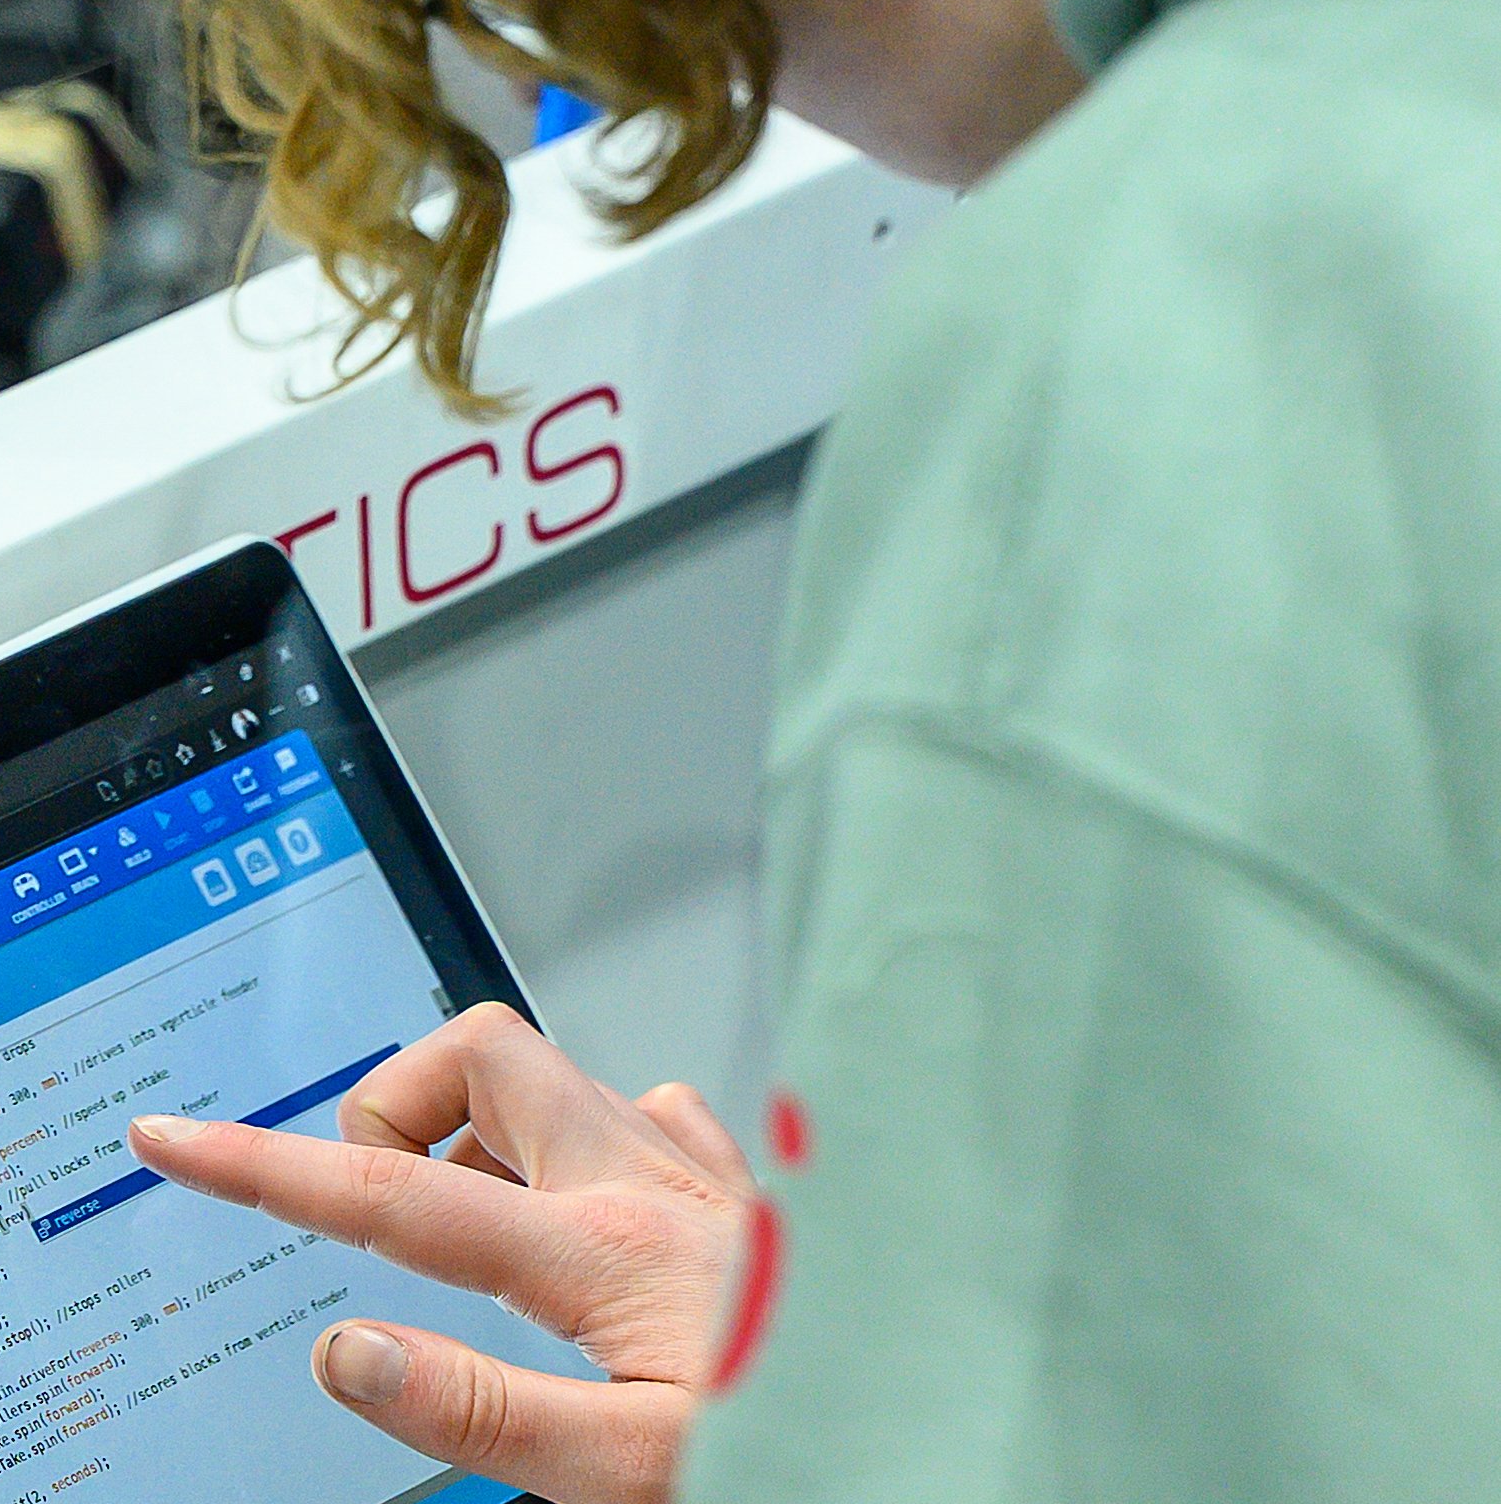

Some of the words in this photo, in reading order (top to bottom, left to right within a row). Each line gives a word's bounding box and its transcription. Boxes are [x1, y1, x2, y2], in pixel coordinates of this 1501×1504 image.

[2, 1039, 35, 1061] drops
[8, 1086, 37, 1105] 300,
[40, 1070, 68, 1089] mm);
[73, 1043, 124, 1076] //drives
[129, 1028, 156, 1047] into
[63, 1095, 108, 1128] //speed
[109, 1086, 129, 1106] up
[131, 1069, 170, 1093] intake
[8, 1173, 47, 1204] //pull
[48, 1155, 90, 1180] blocks
[93, 1139, 123, 1158] from
[53, 1198, 101, 1227] reverse
[56, 1293, 101, 1323] //stops
[106, 1267, 151, 1296] rollers
[130, 1312, 159, 1332] 300,
[195, 1268, 246, 1301] //drives
[248, 1251, 278, 1272] back
[279, 1243, 296, 1256] to
[298, 1226, 327, 1247] lon
[126, 1374, 177, 1409] //scores
[179, 1352, 221, 1379] blocks
[224, 1336, 252, 1356] from
[255, 1309, 307, 1340] verticle
[51, 1457, 110, 1493] seconds);
